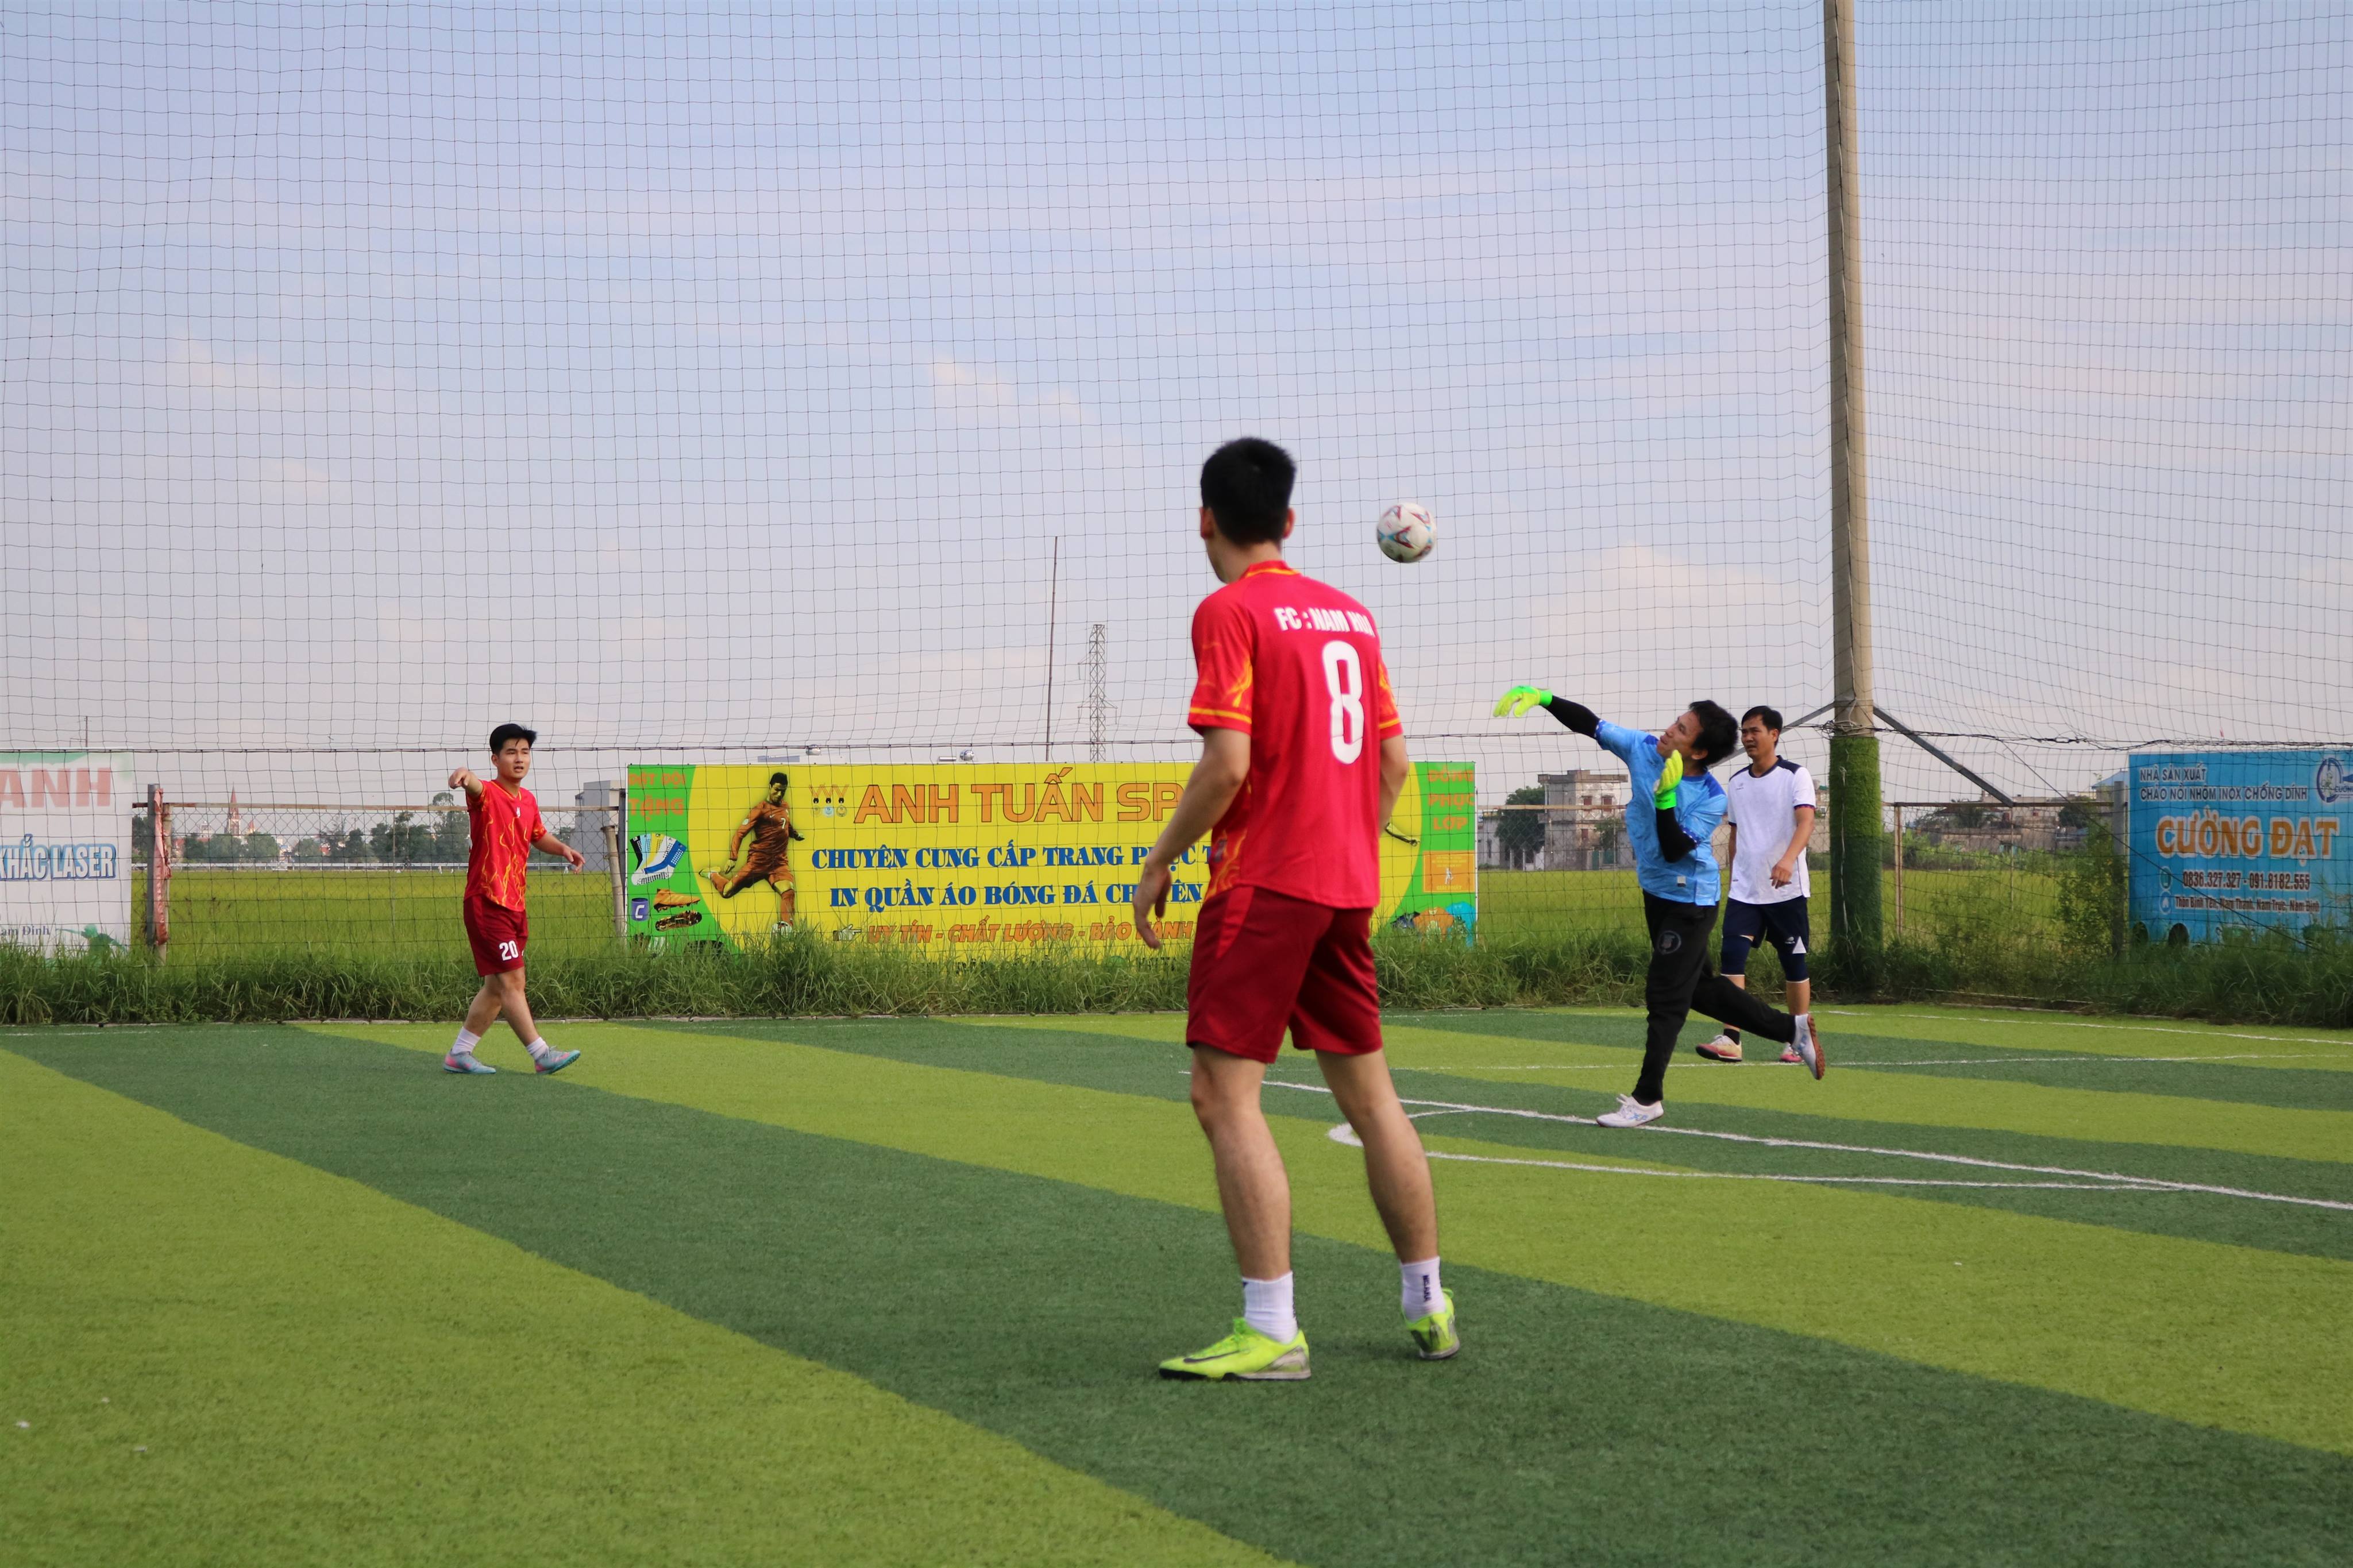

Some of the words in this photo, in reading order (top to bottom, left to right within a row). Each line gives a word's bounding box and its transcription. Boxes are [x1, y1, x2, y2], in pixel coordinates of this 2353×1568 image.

[1274, 607, 1303, 631] FC
[1307, 607, 1351, 632] NAM
[1322, 640, 1364, 764] 8
[0, 767, 112, 809] ANH
[2140, 766, 2160, 781] NHÀ
[853, 785, 959, 824] ANH
[971, 767, 1104, 822] TUẤN
[1117, 782, 1184, 821] SP
[2219, 787, 2241, 801] INOX
[2157, 807, 2262, 856] CƯỜNG
[2270, 820, 2338, 864] ĐẠT
[50, 844, 117, 879] LASER
[812, 845, 909, 868] CHUYÊN
[916, 847, 980, 868] CUNG
[987, 840, 1036, 867] CẤP
[1043, 846, 1124, 866] TRANG
[830, 888, 858, 907] IN
[865, 878, 935, 912] QUẦN
[940, 882, 976, 905] ÁO
[984, 881, 1055, 905] BÓNG
[1063, 880, 1098, 903] ĐÁ
[2183, 871, 2241, 888] 0836.327.327
[2249, 873, 2310, 890] 091.8182.555
[868, 925, 897, 944] UY
[900, 919, 933, 944] TÍN
[948, 915, 1001, 943] CHẤT
[1002, 920, 1074, 947] LƯỢNG
[1089, 916, 1132, 941] BẢO
[499, 940, 519, 961] 20
